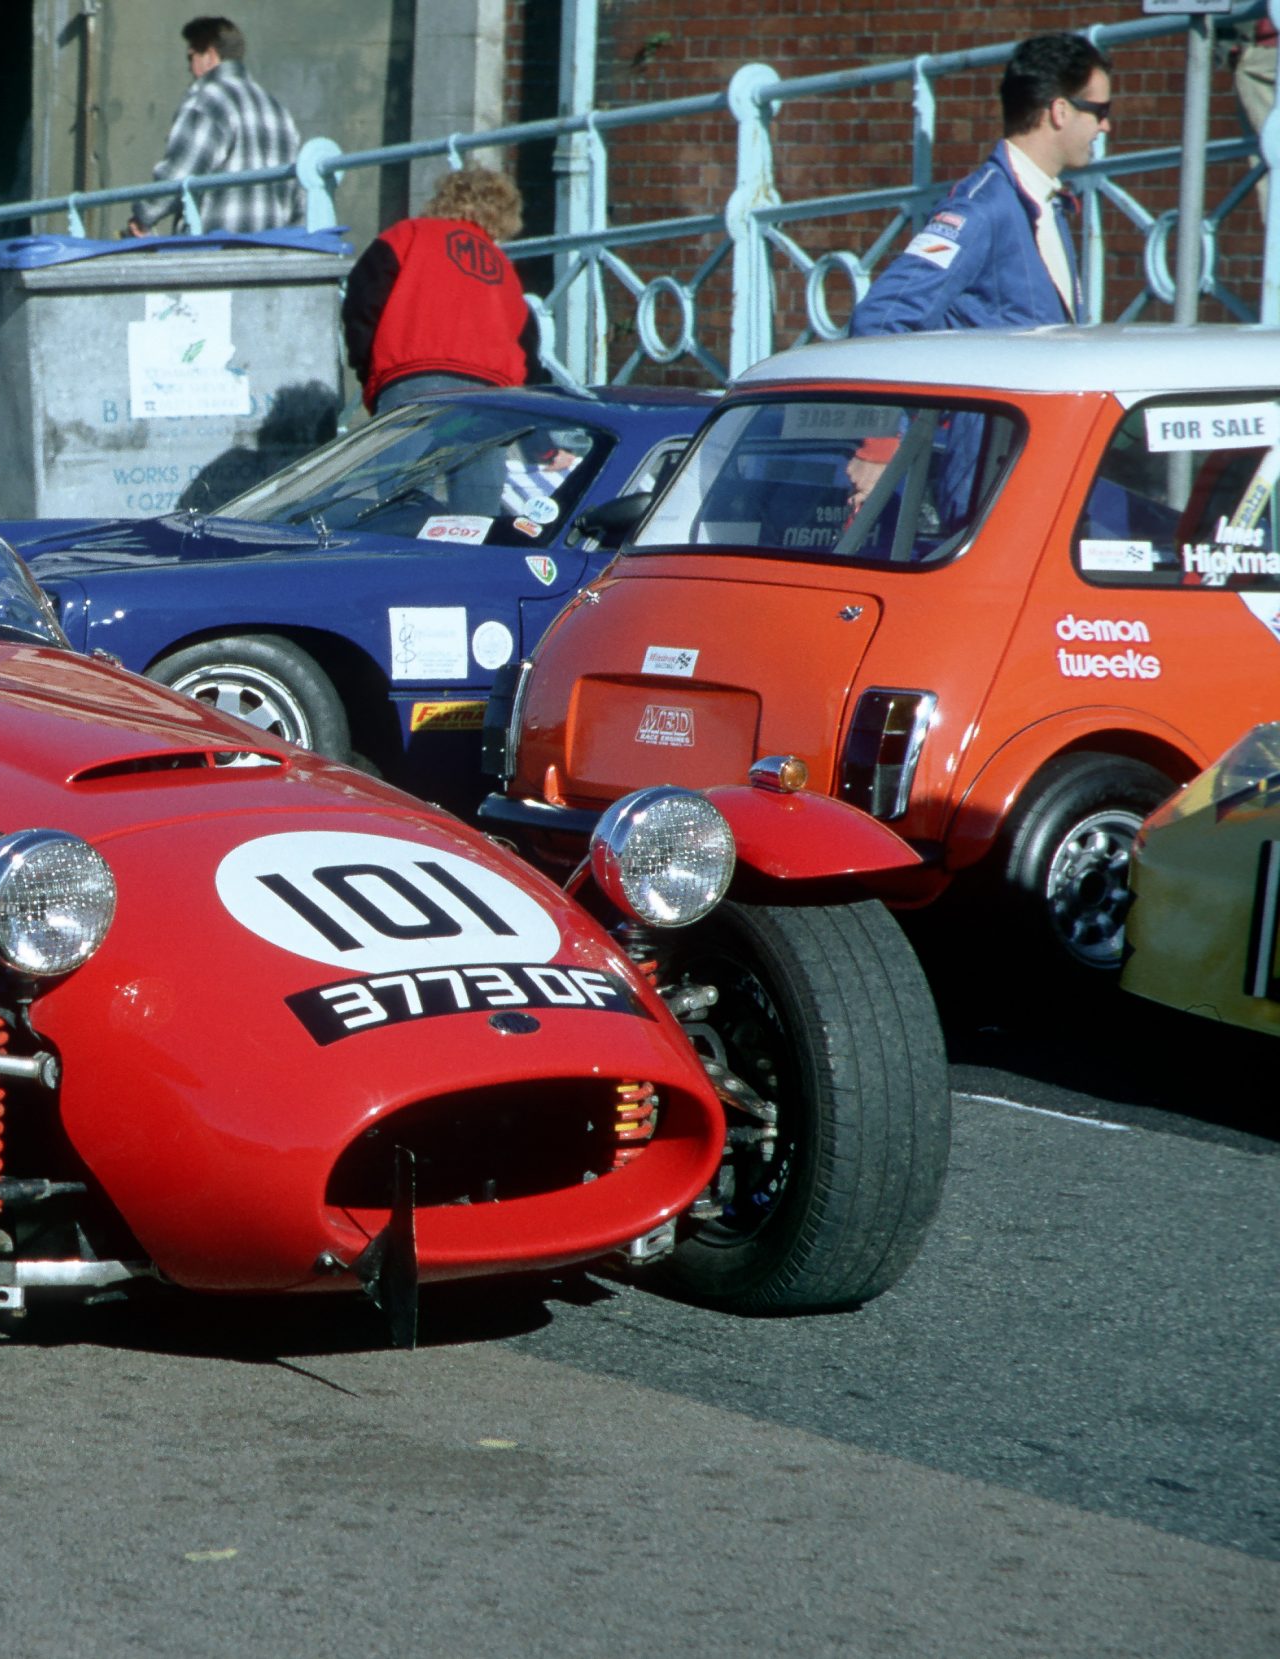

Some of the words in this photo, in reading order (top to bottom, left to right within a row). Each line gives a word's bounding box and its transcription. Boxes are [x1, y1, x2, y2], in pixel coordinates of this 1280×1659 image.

[455, 235, 500, 276] MG
[1161, 420, 1202, 441] FOR
[1213, 416, 1266, 438] SALE
[113, 465, 179, 485] WORKS
[1056, 614, 1151, 642] demon
[1058, 648, 1161, 679] tweeks
[639, 705, 691, 736] MED
[256, 861, 519, 952] 101
[320, 967, 527, 1031] 3773
[524, 967, 617, 1007] DF
